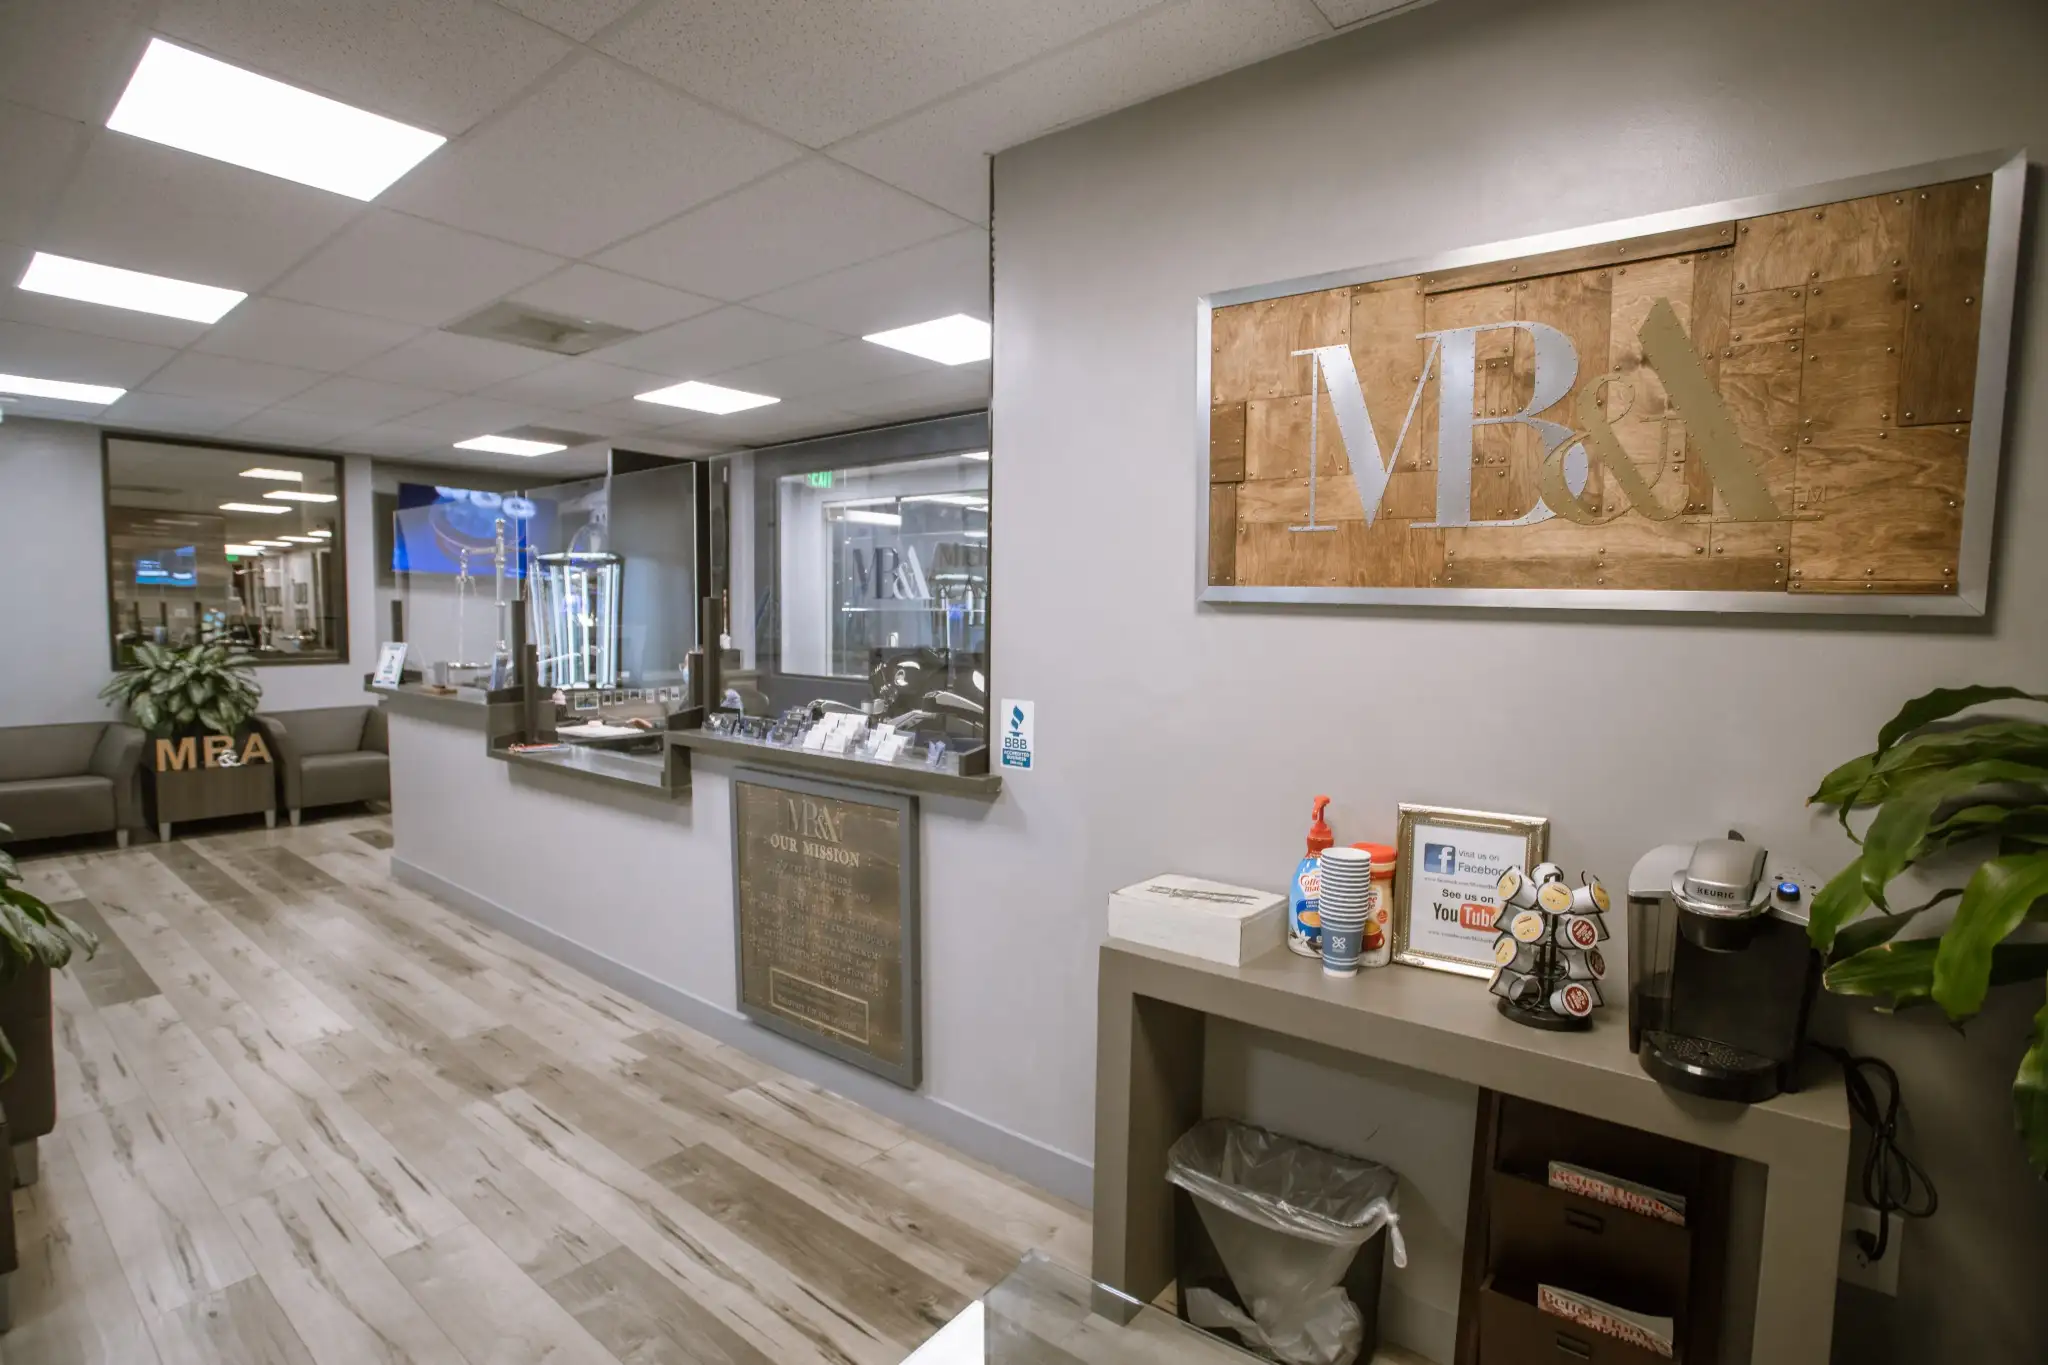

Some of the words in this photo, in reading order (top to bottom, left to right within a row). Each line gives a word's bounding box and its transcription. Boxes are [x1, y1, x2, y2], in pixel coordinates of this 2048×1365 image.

[1004, 737, 1027, 749] BBB
[770, 833, 798, 853] OUR
[803, 840, 860, 868] MISSION
[1458, 849, 1475, 858] Visit
[1458, 862, 1504, 876] Facebo
[1442, 888, 1461, 899] See
[1465, 893, 1477, 901] us
[1480, 896, 1494, 904] on
[1696, 886, 1735, 900] KEURIG
